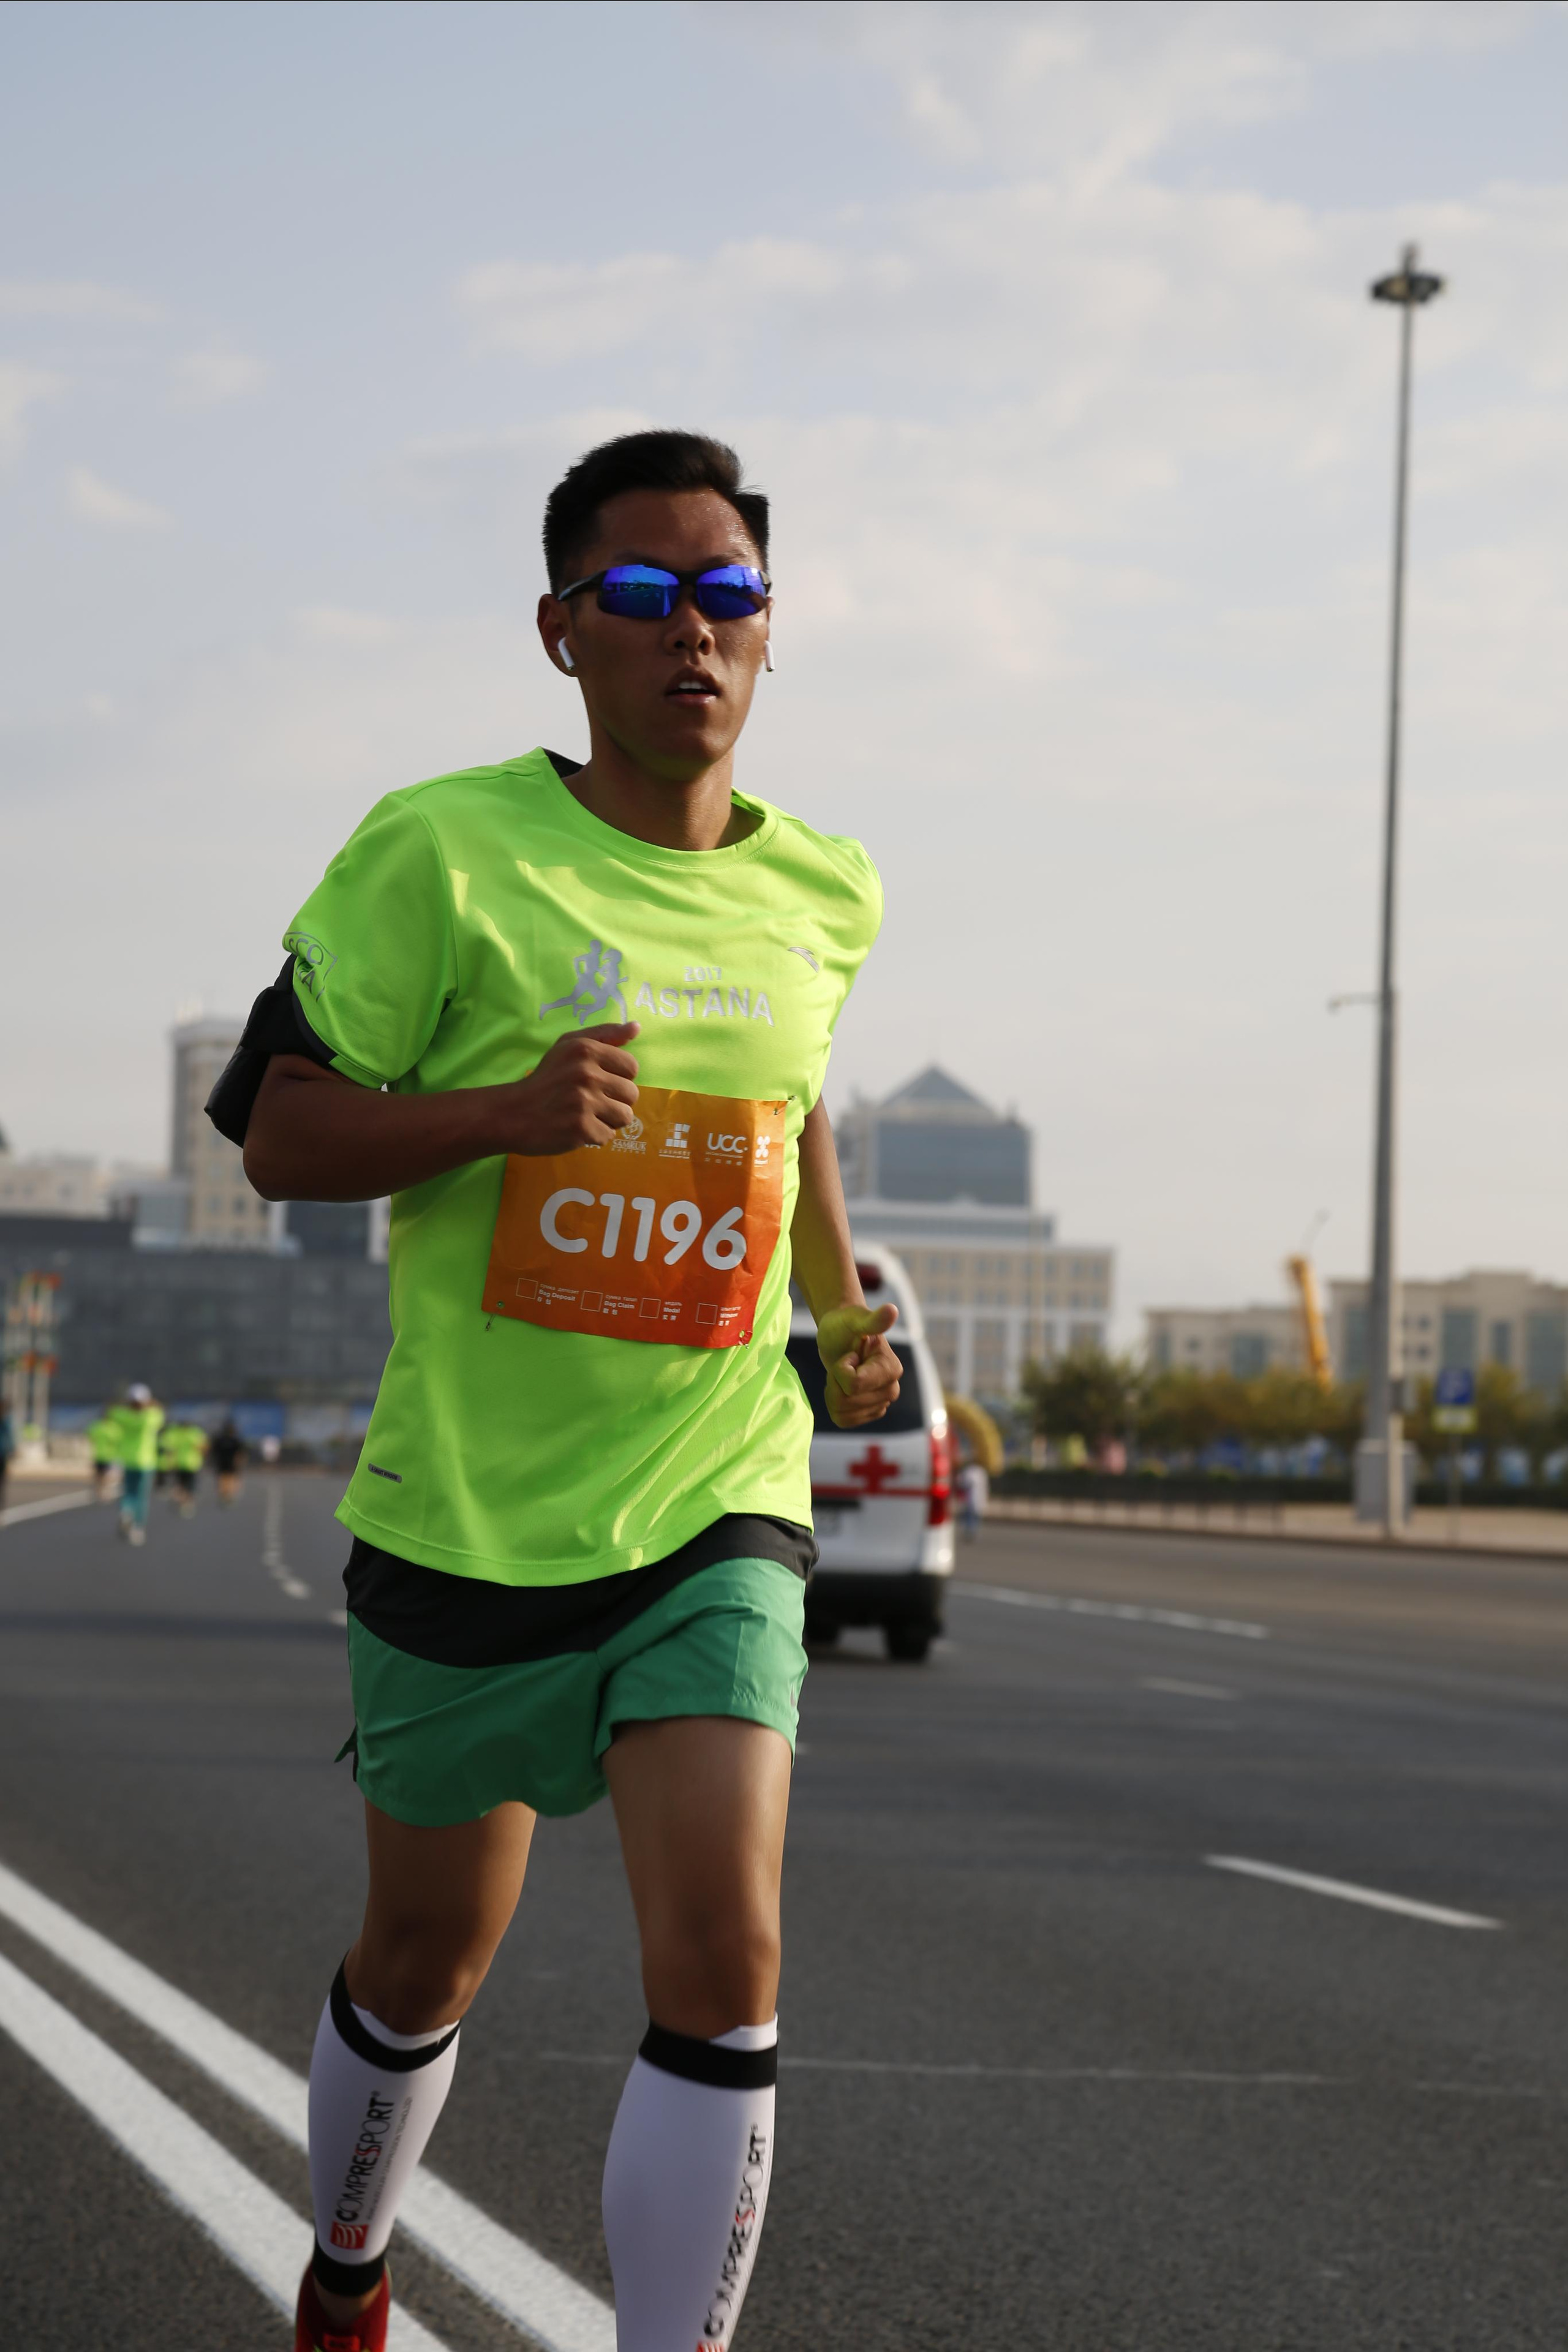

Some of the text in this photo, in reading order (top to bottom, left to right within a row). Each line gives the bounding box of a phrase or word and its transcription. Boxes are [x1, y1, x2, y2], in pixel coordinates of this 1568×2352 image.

[684, 966, 722, 982] 2017
[635, 981, 774, 1027] ASTANA
[612, 1139, 647, 1151] SAMRUK
[540, 1188, 747, 1270] C1196
[538, 1289, 576, 1302] Bag Deposit
